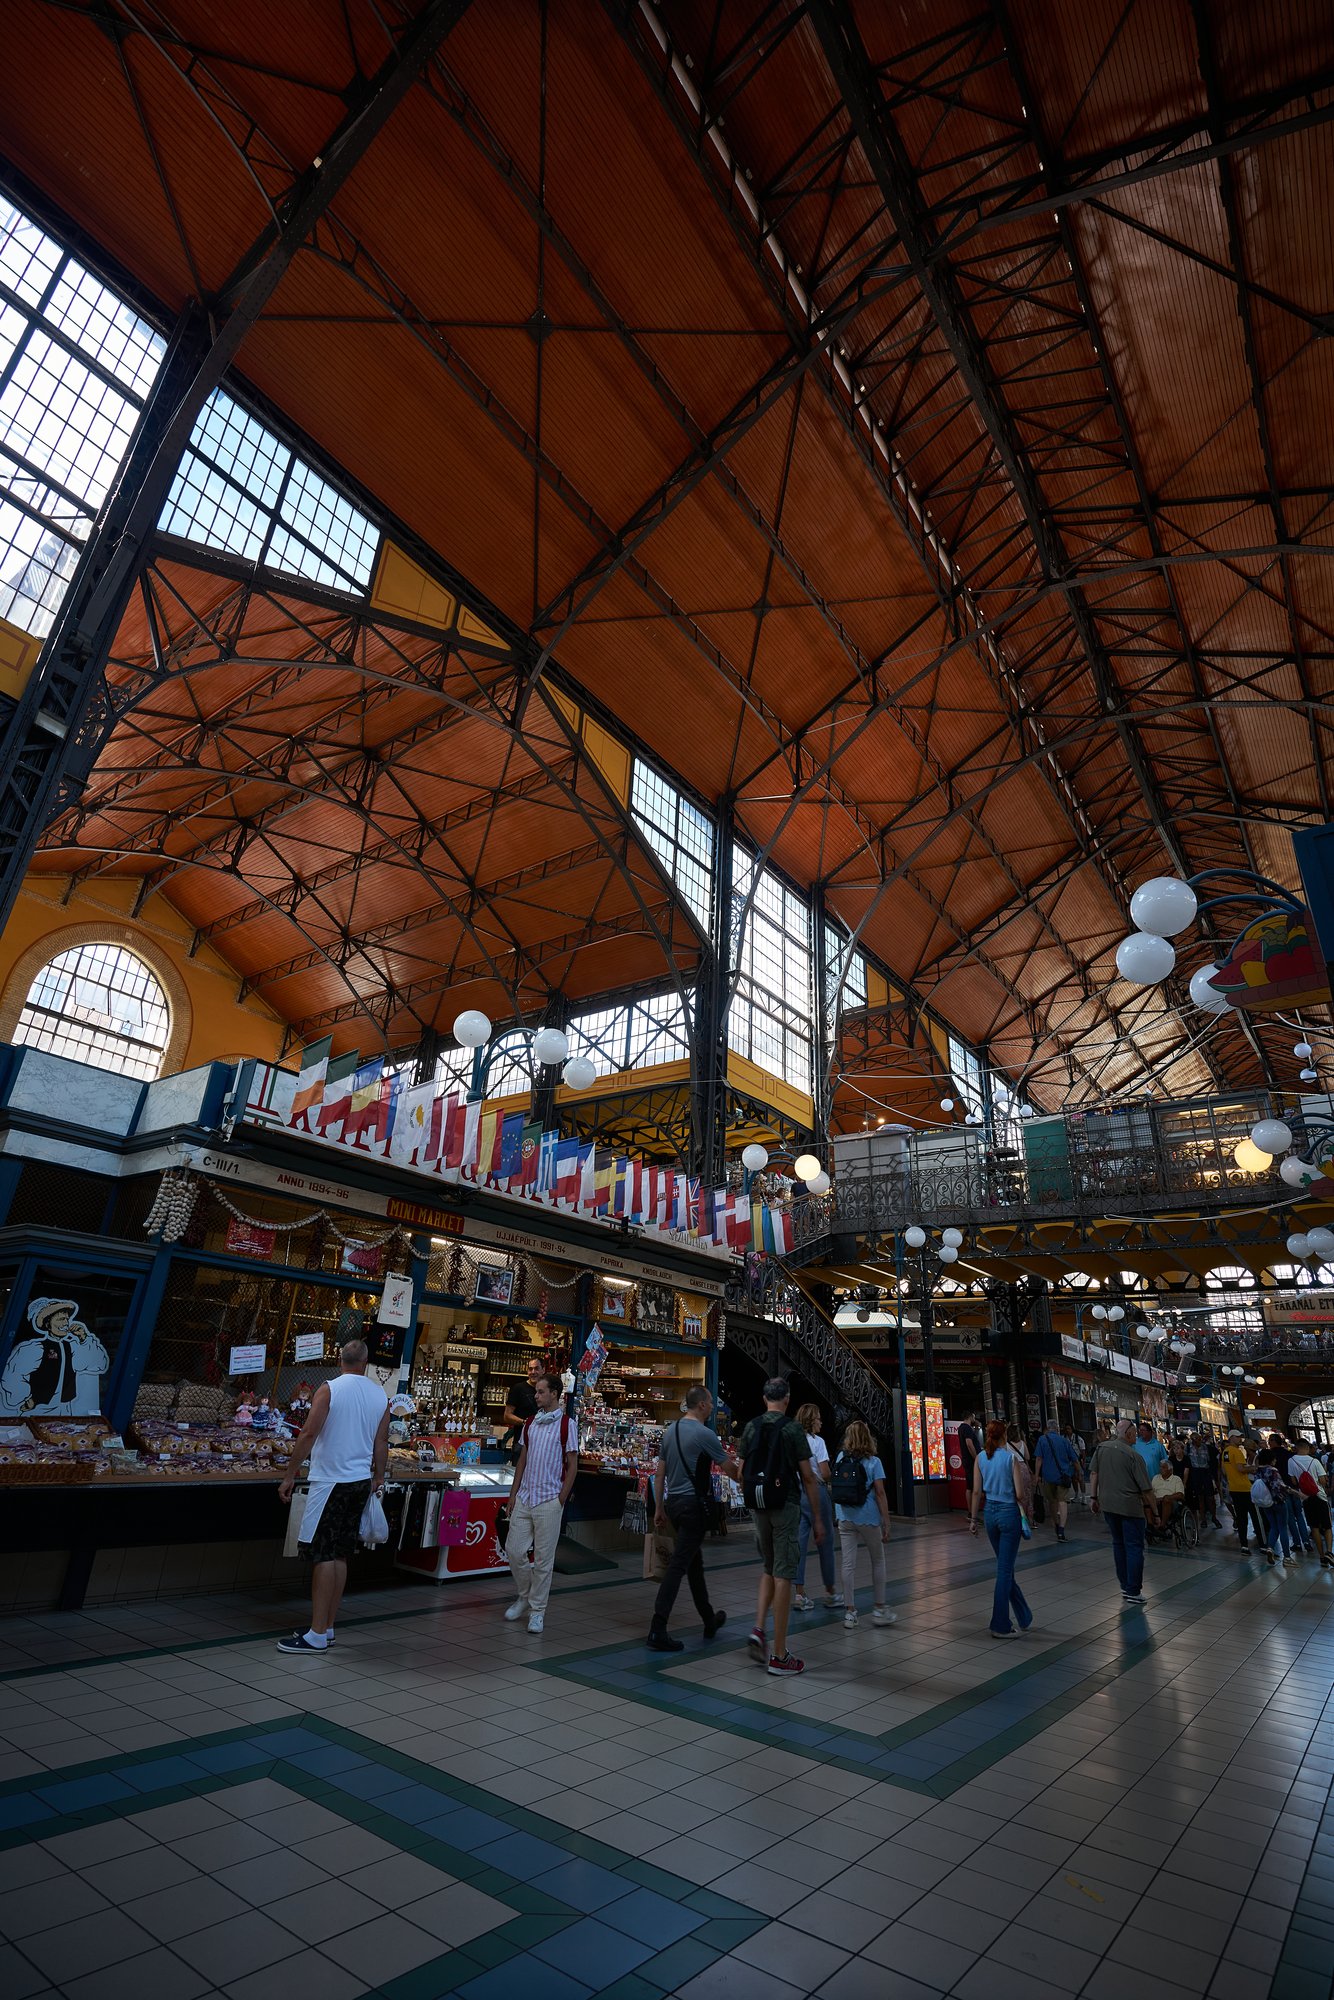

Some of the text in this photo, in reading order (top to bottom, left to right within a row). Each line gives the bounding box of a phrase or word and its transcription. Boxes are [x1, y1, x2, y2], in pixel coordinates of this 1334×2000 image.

[277, 1173, 350, 1200] ANNO 1894-96
[389, 1198, 465, 1232] MINI MARKET
[600, 1256, 624, 1269] PAPRIKA
